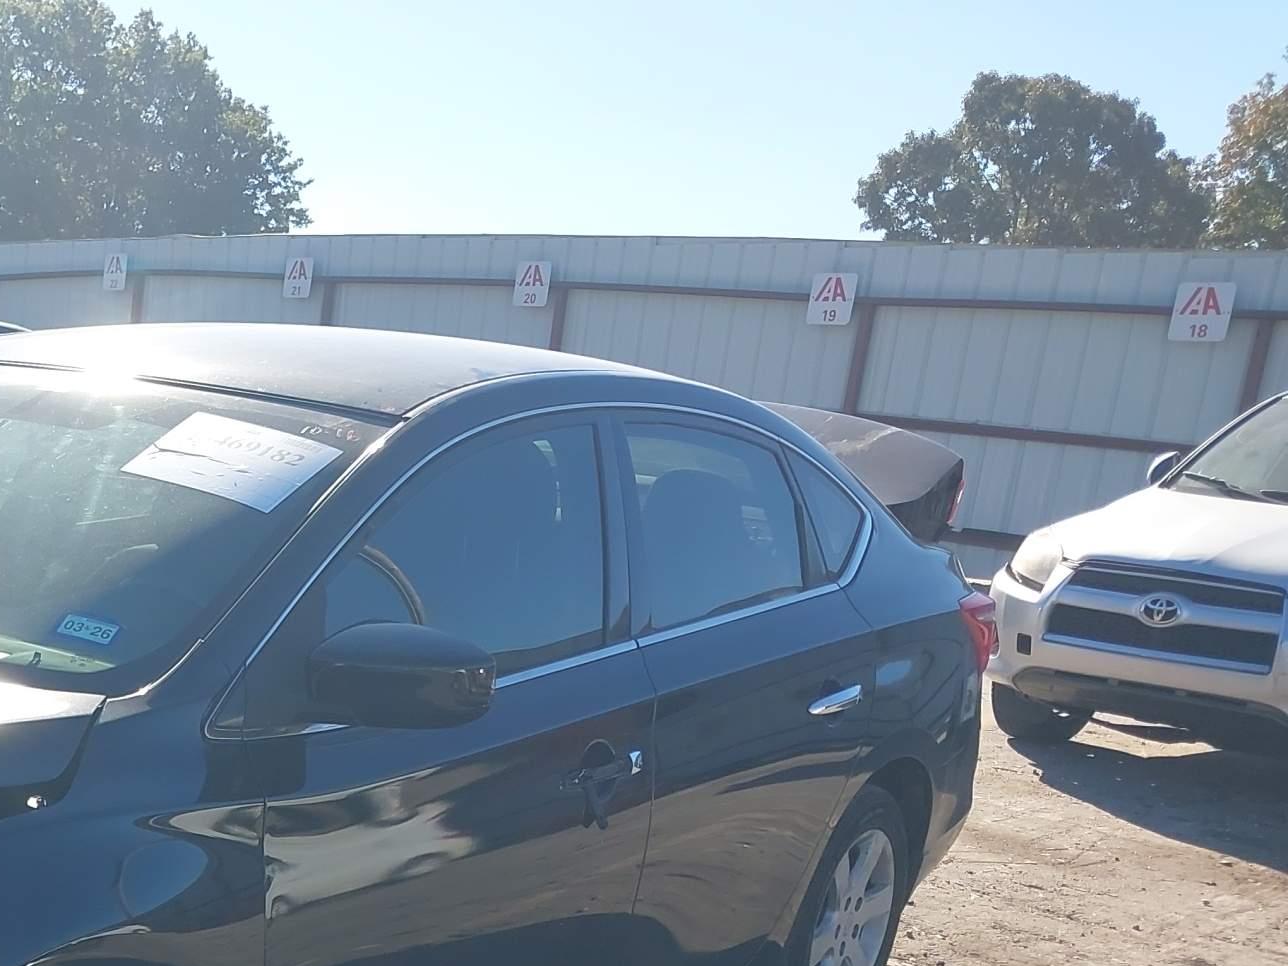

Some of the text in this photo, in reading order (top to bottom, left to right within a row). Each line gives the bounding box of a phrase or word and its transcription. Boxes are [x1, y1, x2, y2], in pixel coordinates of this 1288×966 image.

[291, 286, 302, 296] 21
[523, 293, 537, 304] 20
[822, 309, 837, 322] 19
[1190, 324, 1209, 338] 18
[63, 620, 113, 639] 03 26
